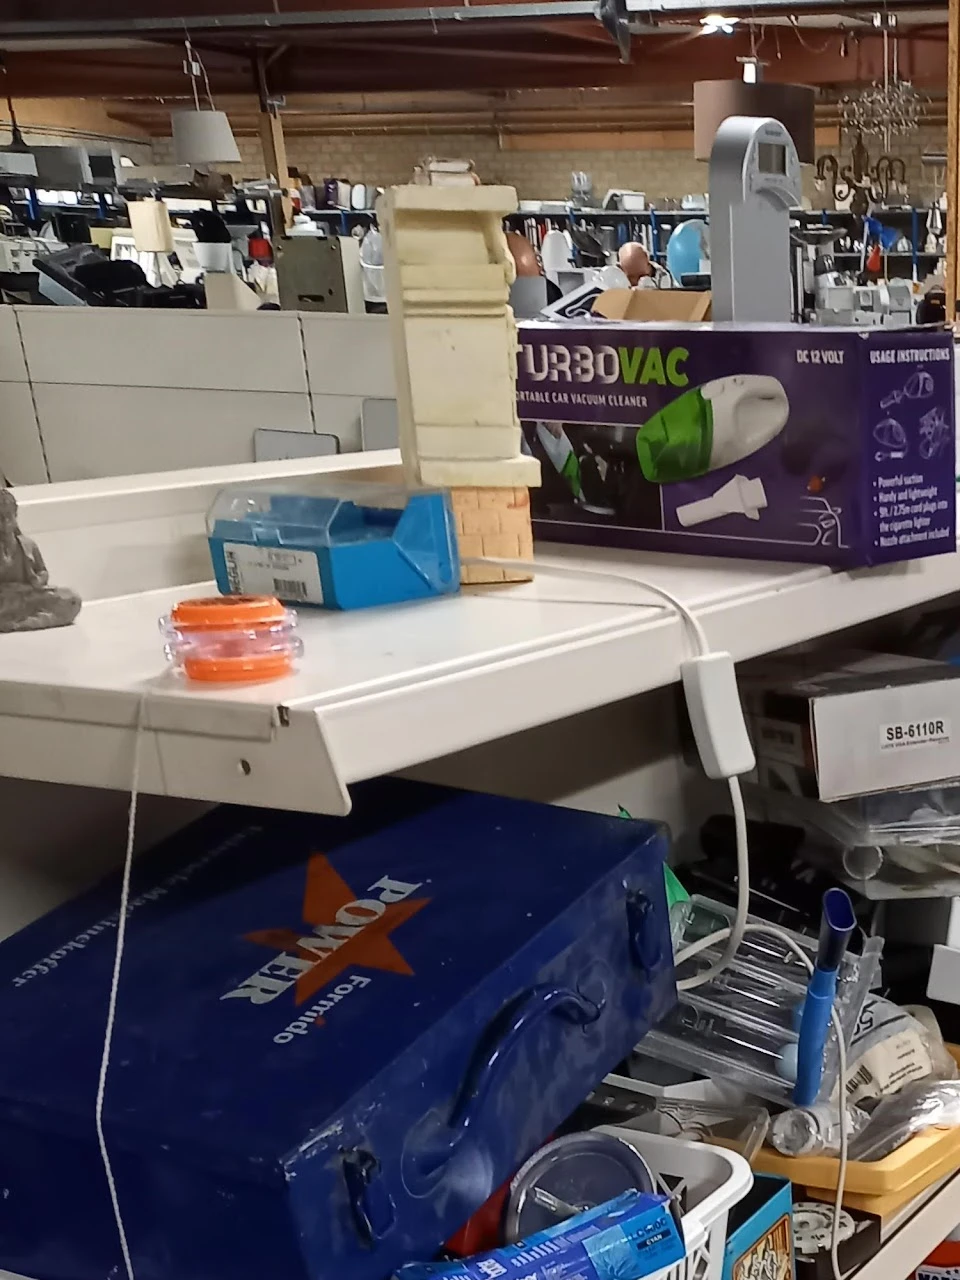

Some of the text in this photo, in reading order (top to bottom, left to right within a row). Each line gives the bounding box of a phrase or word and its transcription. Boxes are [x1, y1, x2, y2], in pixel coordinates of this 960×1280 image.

[517, 344, 689, 387] URBOVAC
[796, 349, 845, 364] DC 12 VOLT
[869, 348, 950, 364] USAGE INSTRUCTIONS
[516, 390, 648, 408] ORTABLE CAR VACUUM CLEANER
[886, 720, 945, 741] SB-6110R
[219, 874, 424, 1005] POWER
[272, 974, 372, 1044] Formido
[645, 1233, 663, 1246] CYAN
